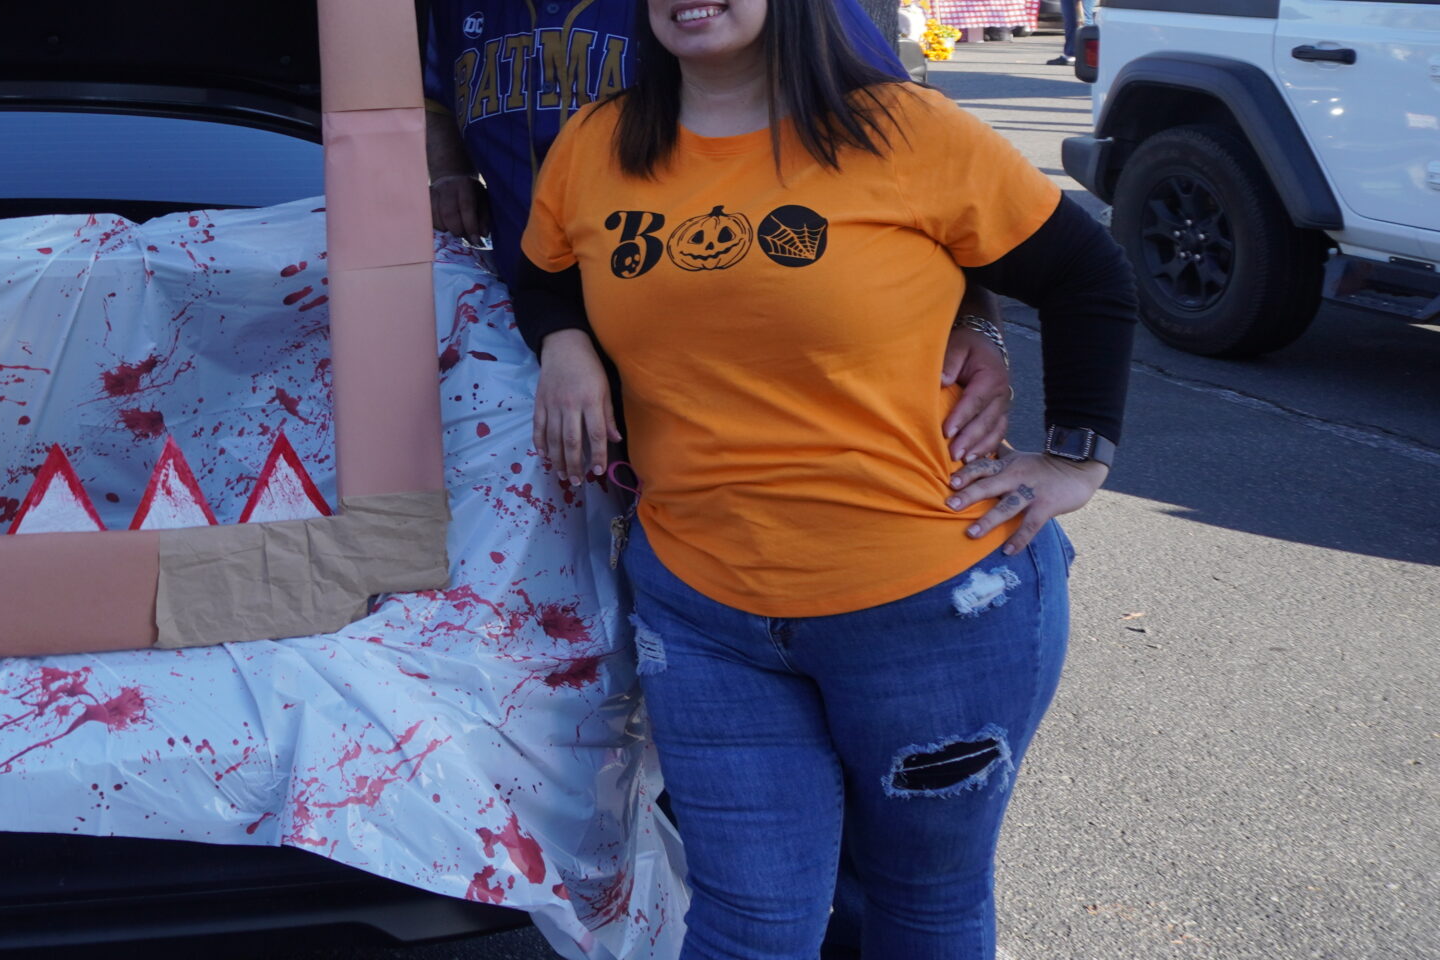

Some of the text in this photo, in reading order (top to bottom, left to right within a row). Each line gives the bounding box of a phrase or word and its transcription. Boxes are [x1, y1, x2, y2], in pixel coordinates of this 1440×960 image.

[464, 17, 483, 33] DC
[455, 27, 629, 124] BATMA
[604, 204, 828, 279] BOO
